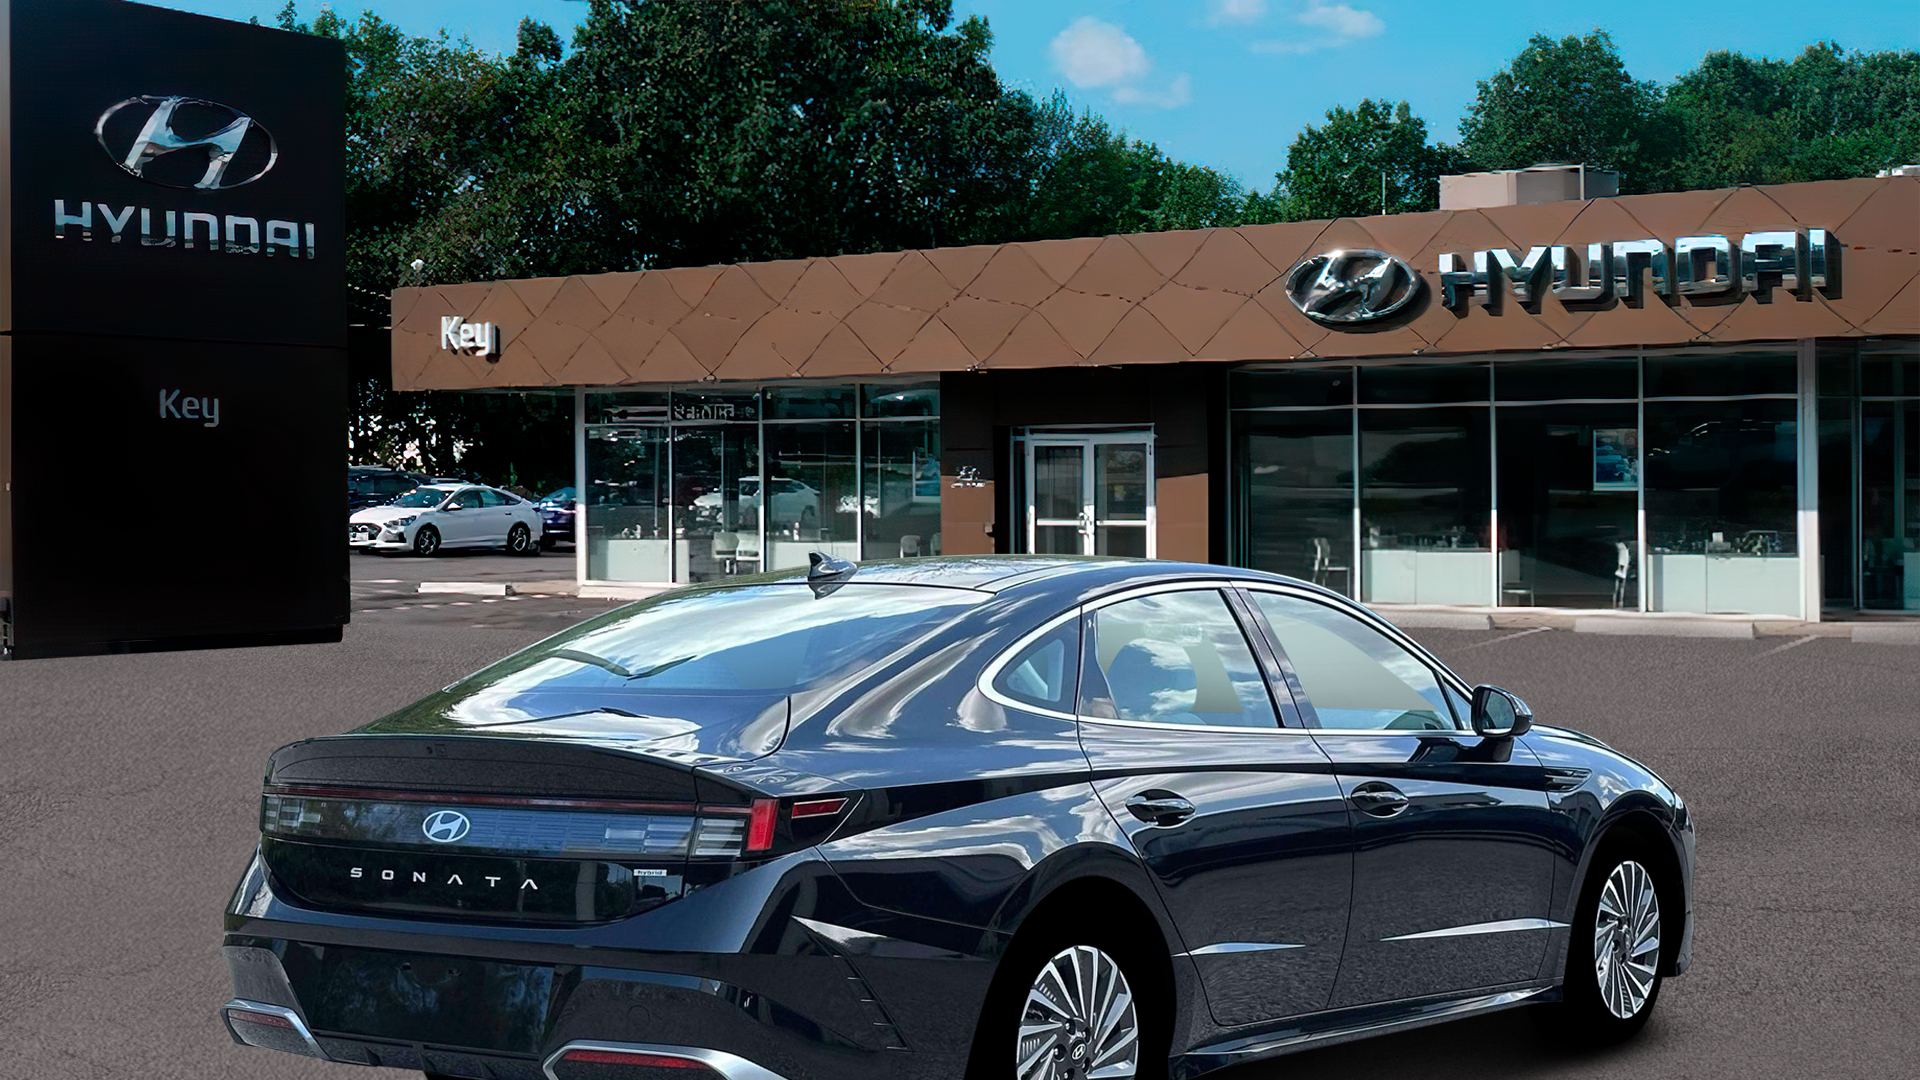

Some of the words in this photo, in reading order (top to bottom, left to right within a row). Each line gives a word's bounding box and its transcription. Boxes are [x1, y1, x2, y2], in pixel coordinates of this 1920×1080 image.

[54, 199, 316, 260] HYUNDAI
[1438, 228, 1838, 314] HYUNDAI
[441, 315, 494, 357] Key
[159, 388, 220, 428] Key
[350, 867, 539, 890] SONATA
